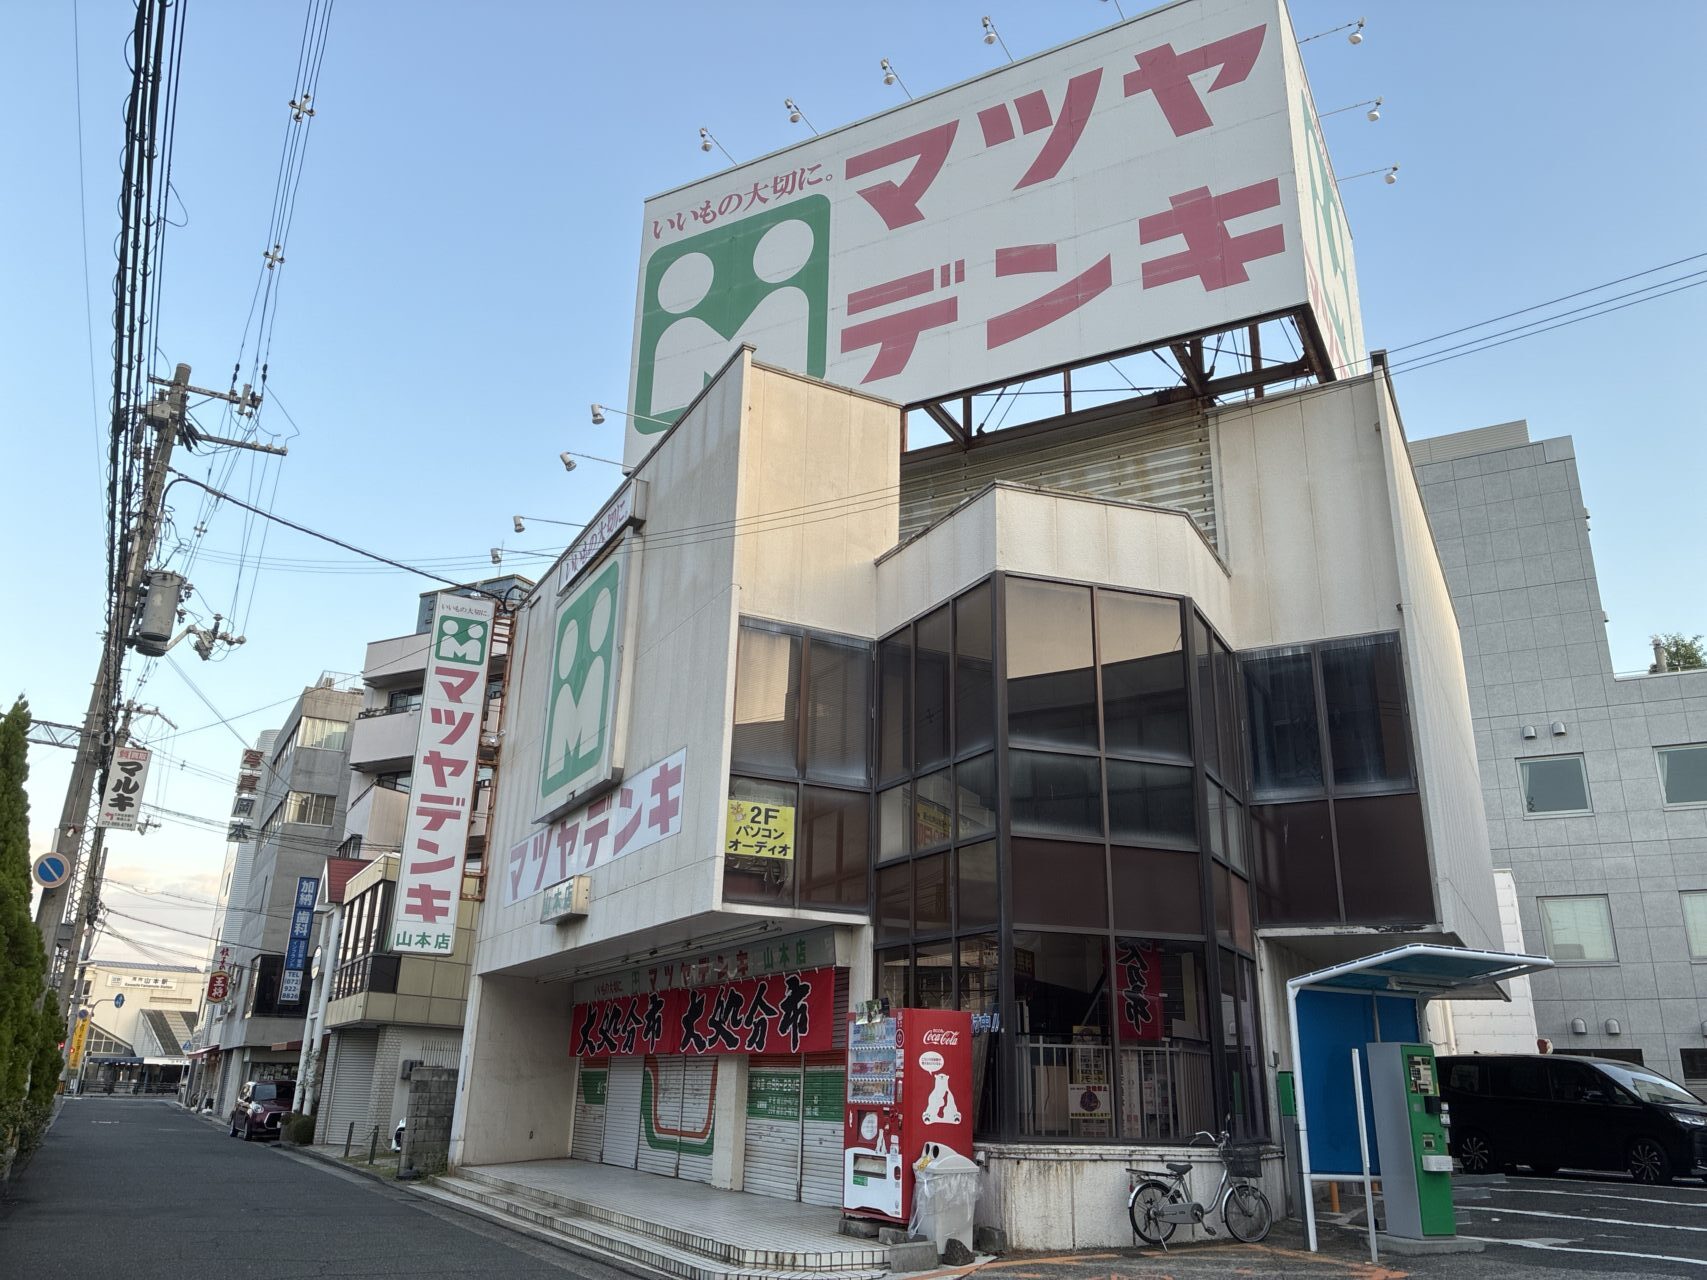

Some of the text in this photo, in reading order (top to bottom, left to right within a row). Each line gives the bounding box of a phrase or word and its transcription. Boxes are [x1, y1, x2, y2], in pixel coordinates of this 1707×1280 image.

[845, 23, 1267, 231] マツヤ
[652, 163, 833, 240] いいもの大切に。
[840, 177, 1287, 384] デンキ
[108, 761, 144, 812] マルキ
[404, 665, 480, 924] マツヤデンキ
[509, 762, 683, 902] マツヤデンキ
[735, 824, 785, 841] パソコン
[750, 805, 780, 825] 2F
[728, 838, 791, 857] オーディオ
[544, 881, 573, 916] 山本店
[395, 930, 451, 950] 山本店
[763, 939, 807, 970] 山本店
[647, 949, 749, 992] マツヤデンキ
[680, 974, 812, 1054] 大処分市
